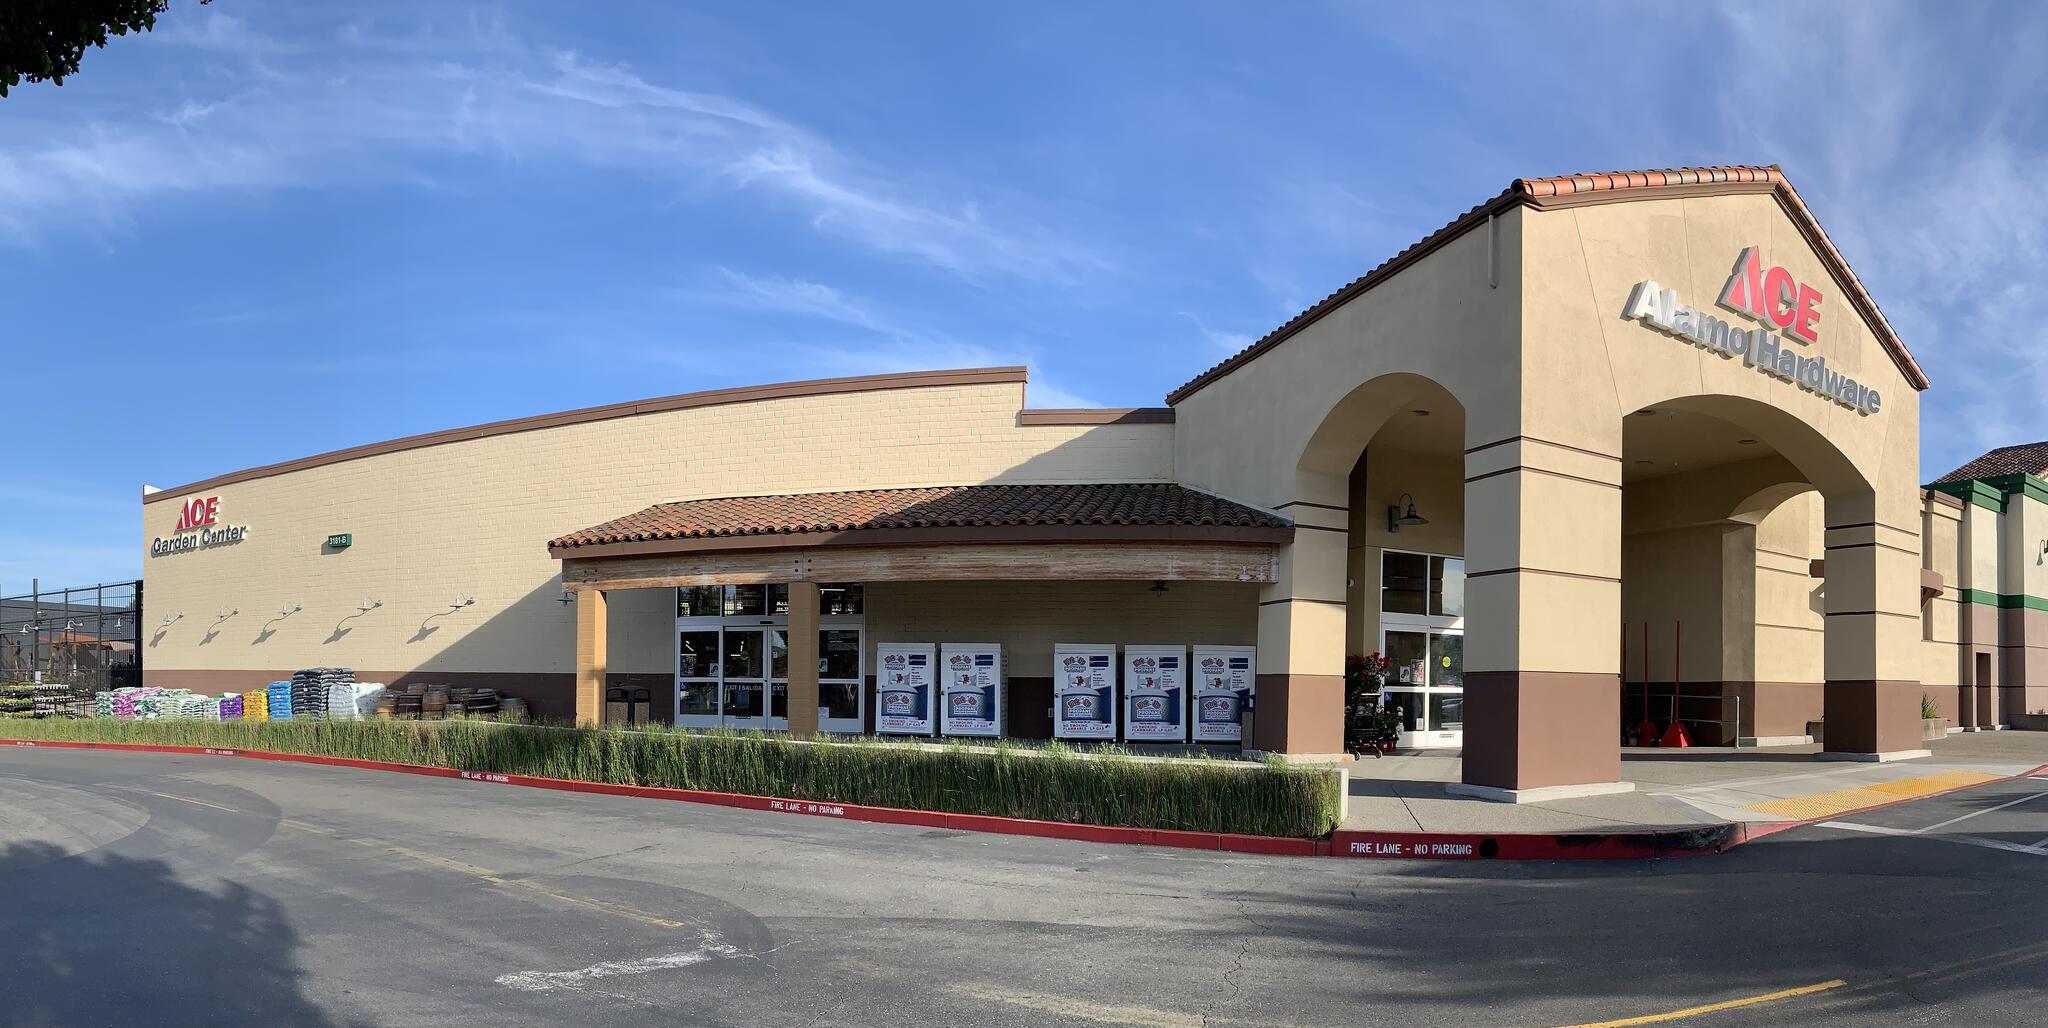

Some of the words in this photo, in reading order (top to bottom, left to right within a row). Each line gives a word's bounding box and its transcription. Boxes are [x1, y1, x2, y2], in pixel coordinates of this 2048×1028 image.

[1720, 244, 1823, 344] ACE
[1630, 278, 1749, 356] Alamo
[1753, 327, 1881, 416] Hardware
[176, 496, 219, 530] ACE
[153, 534, 198, 554] Garden
[202, 525, 247, 545] Center
[771, 801, 784, 809] FIRE
[786, 802, 801, 812] LANE
[808, 804, 817, 812] NO
[819, 806, 844, 815] PARKING
[1350, 842, 1372, 854] FIRE
[1376, 843, 1402, 854] LANE
[1414, 844, 1428, 855] NO
[1432, 844, 1472, 855] PARKING
